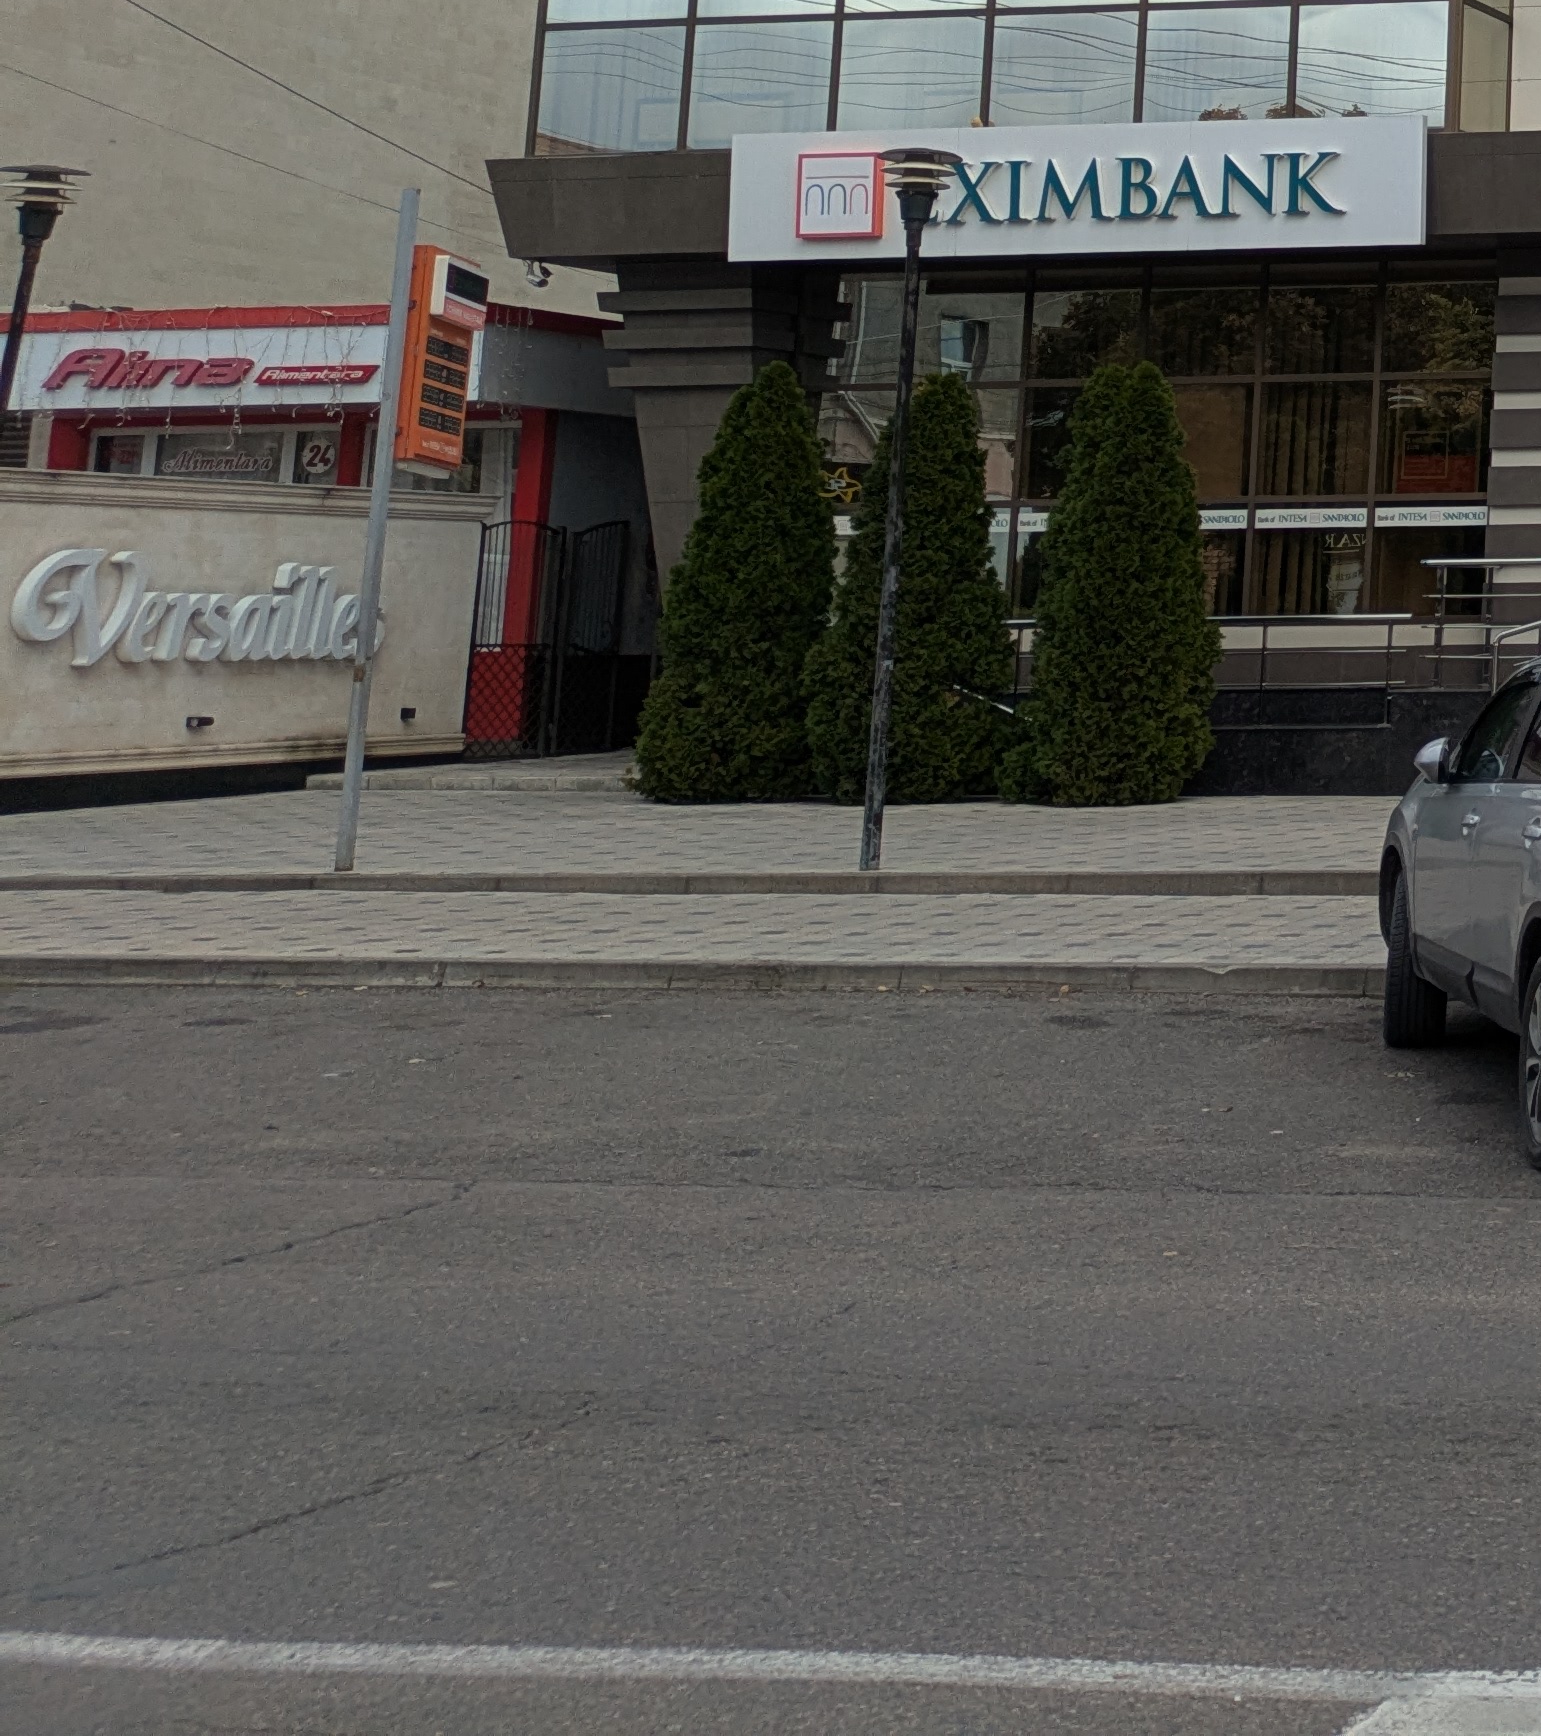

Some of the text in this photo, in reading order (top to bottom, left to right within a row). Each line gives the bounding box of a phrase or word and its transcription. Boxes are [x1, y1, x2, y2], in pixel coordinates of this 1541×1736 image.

[903, 151, 1348, 226] XIMBANK
[305, 444, 332, 467] 24
[1278, 514, 1307, 523] INTESA
[1398, 512, 1428, 522] INTESA
